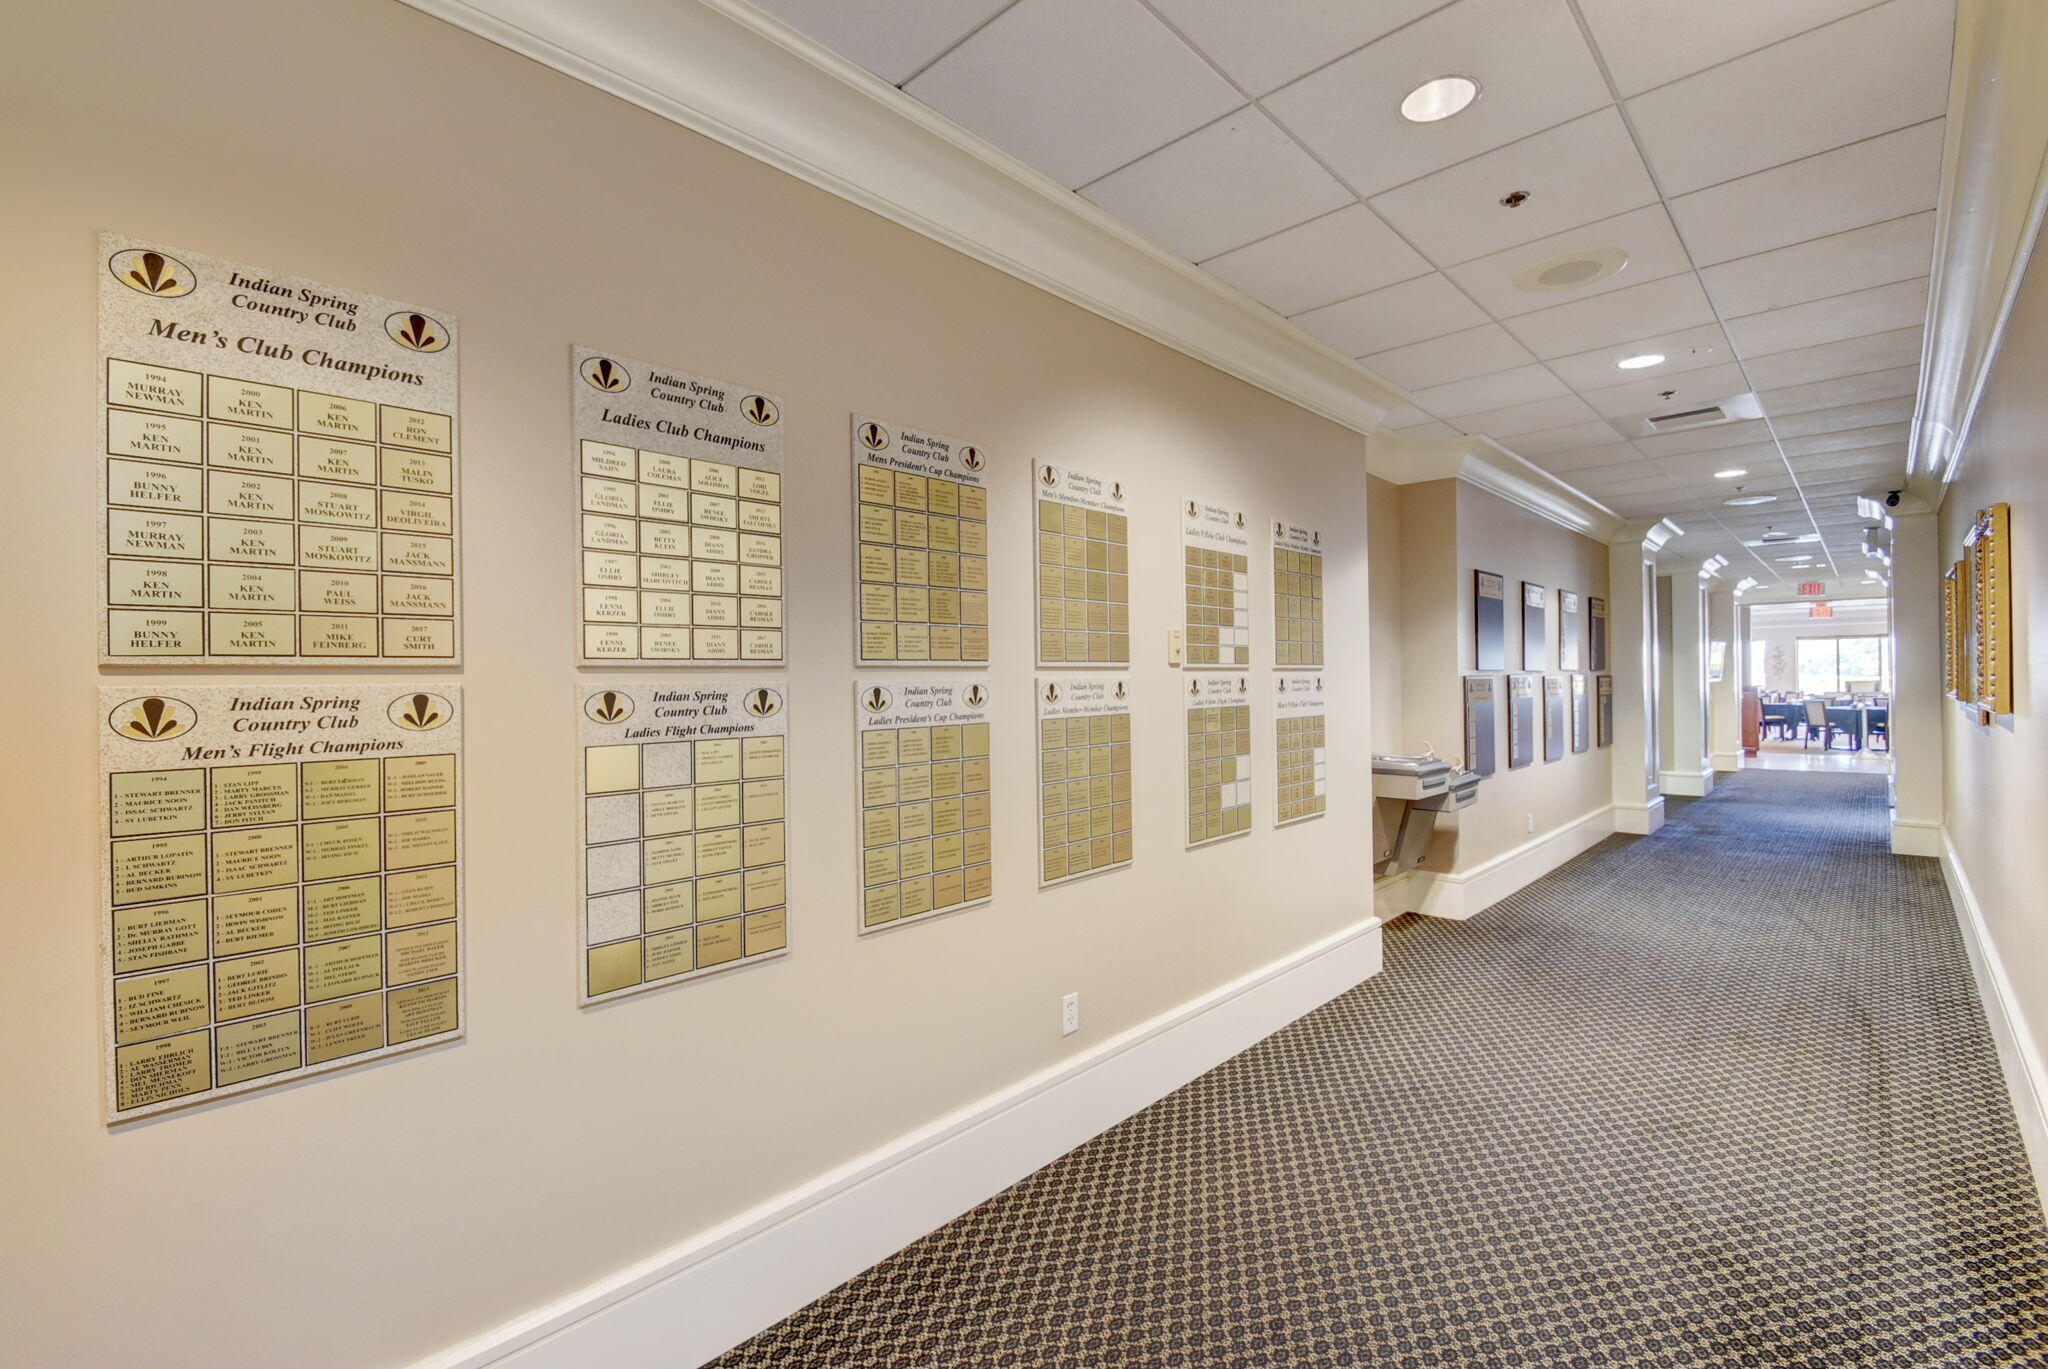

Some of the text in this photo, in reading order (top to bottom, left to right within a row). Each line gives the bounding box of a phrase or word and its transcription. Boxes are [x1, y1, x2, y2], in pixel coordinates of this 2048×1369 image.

[229, 272, 359, 315] Indian Spring
[232, 295, 357, 332] Country Club
[148, 318, 424, 386] Men's Club Champions
[145, 374, 166, 382] 1994
[128, 382, 183, 397] MURRAY
[649, 372, 725, 400] Indian Spring
[126, 391, 184, 405] NEWMAN
[241, 389, 260, 397] 2000
[239, 400, 262, 408] KEN
[651, 388, 724, 413] Country Club
[228, 407, 273, 418] MARTIN
[327, 414, 348, 422] KEN
[145, 422, 166, 430] 1995
[317, 420, 358, 431] MARTIN
[407, 426, 427, 434] RON
[602, 409, 765, 452] Ladies Club Champions
[143, 433, 168, 442] KEN
[241, 435, 260, 443] 2001
[393, 432, 439, 444] CLEMENT
[901, 432, 949, 452] Indian Spring
[130, 441, 181, 453] MARTIN
[239, 446, 262, 454] KEN
[228, 453, 273, 464] MARTIN
[902, 445, 949, 462] Country Club
[328, 458, 348, 466] KEN
[317, 465, 359, 475] MARTIN
[401, 468, 432, 476] MALIN
[867, 453, 979, 483] Mens President's Cup Champions
[401, 476, 433, 485] TUSKO
[134, 482, 177, 492] BUNNY
[130, 490, 181, 501] HELFER
[228, 500, 273, 510] MARTIN
[317, 501, 359, 511] STUART
[304, 508, 371, 520] MOSKOWITZ
[400, 510, 433, 518] VIRGIL
[387, 516, 446, 527] DEOLIVEIRA
[128, 531, 183, 541] MURRAY
[126, 540, 185, 550] NEWMAN
[318, 545, 359, 553] STUART
[230, 547, 276, 556] MARTIN
[305, 552, 372, 563] MOSKOWITZ
[389, 558, 446, 567] MANSMANN
[131, 590, 182, 598] MARTIN
[1802, 583, 1823, 595] EXIT
[131, 640, 181, 648] HELFER
[654, 690, 728, 703] Indian Spring
[930, 687, 953, 696] Spring
[230, 697, 361, 712] Indian Spring
[905, 698, 952, 708] Country Club
[655, 704, 727, 719] Country Club
[232, 716, 359, 733] Country Club
[869, 713, 984, 726] Ladies President's Cup Champions
[624, 724, 755, 738] Ladies Flight Champions
[182, 739, 404, 761] Men's Flight Champions
[125, 791, 162, 799] STEWART
[150, 805, 193, 813] SCHWARTZ
